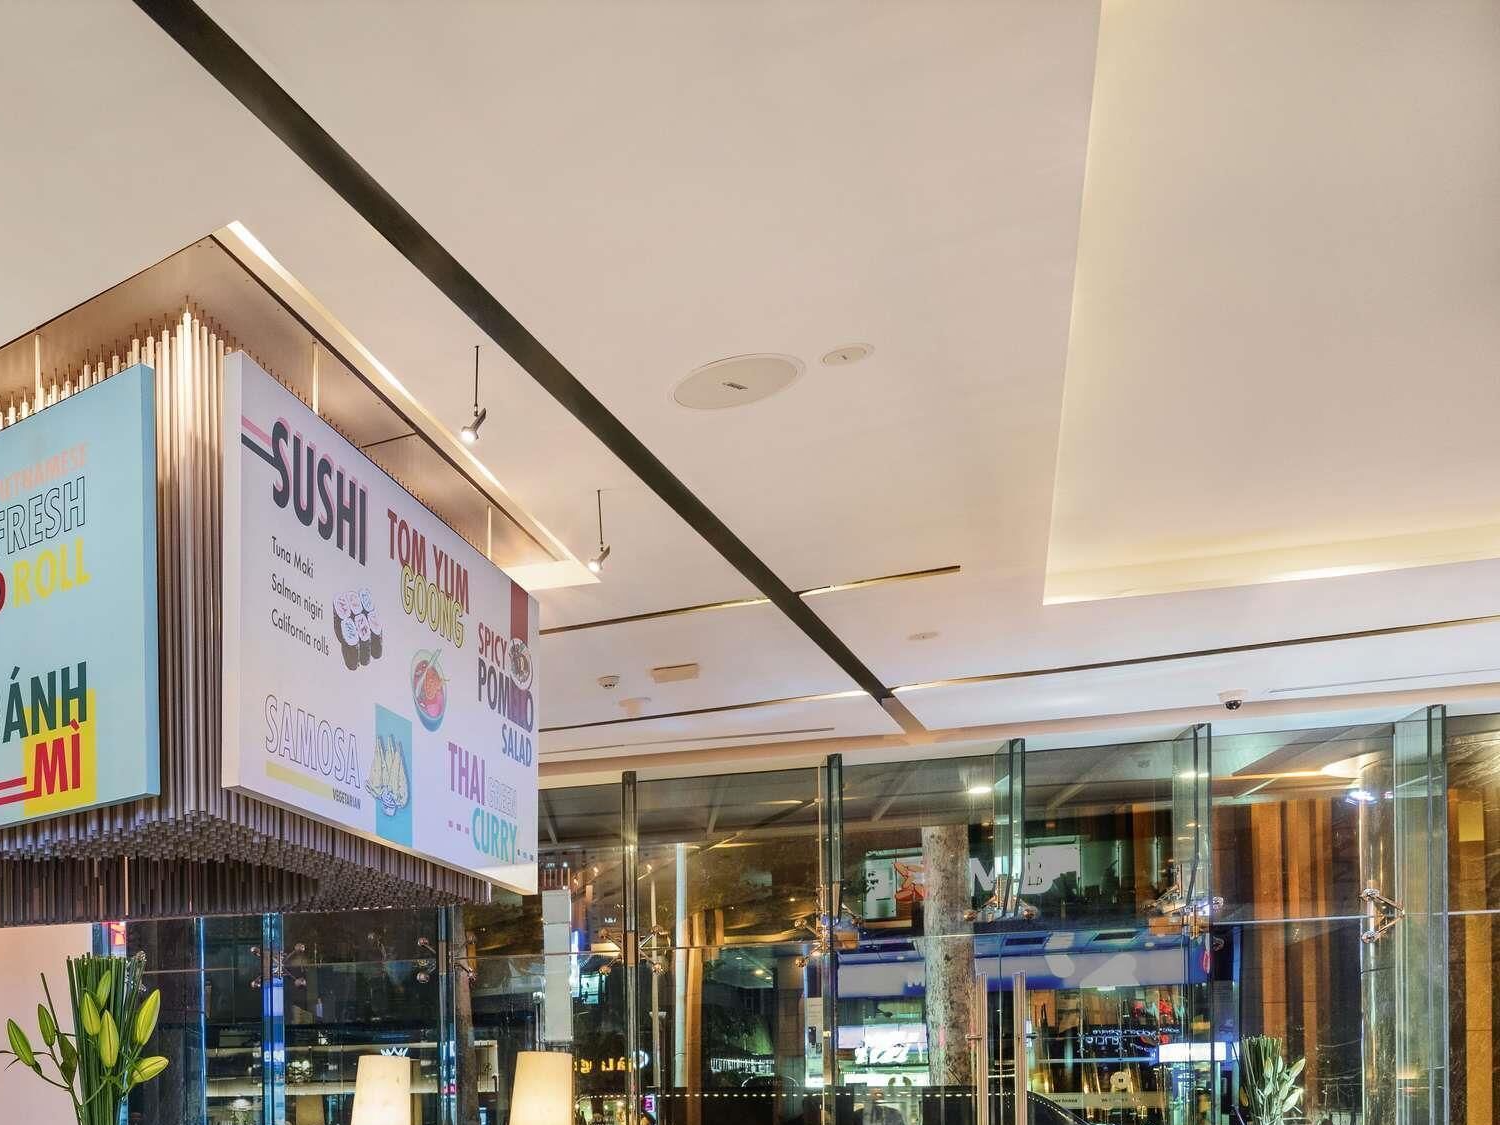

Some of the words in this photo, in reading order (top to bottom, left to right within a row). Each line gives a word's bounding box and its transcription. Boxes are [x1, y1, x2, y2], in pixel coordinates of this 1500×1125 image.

[272, 416, 369, 567] SUSHI
[12, 538, 92, 609] ROLL
[271, 535, 291, 564] Tuna
[293, 551, 314, 579] Maki
[388, 508, 427, 579] TOM
[433, 544, 470, 615] YUM
[271, 573, 301, 608] Salmon
[303, 598, 324, 622] nigiri
[401, 564, 465, 649] GOONG
[271, 608, 311, 645] California
[313, 636, 329, 656] rolls
[478, 622, 508, 669] SPICY
[478, 656, 534, 733] POMO
[265, 694, 361, 789] SAMOSA
[502, 723, 532, 768] SALAD
[332, 788, 361, 810] VEGETARIAN
[448, 741, 486, 806] THAI
[471, 807, 518, 864] CURRY
